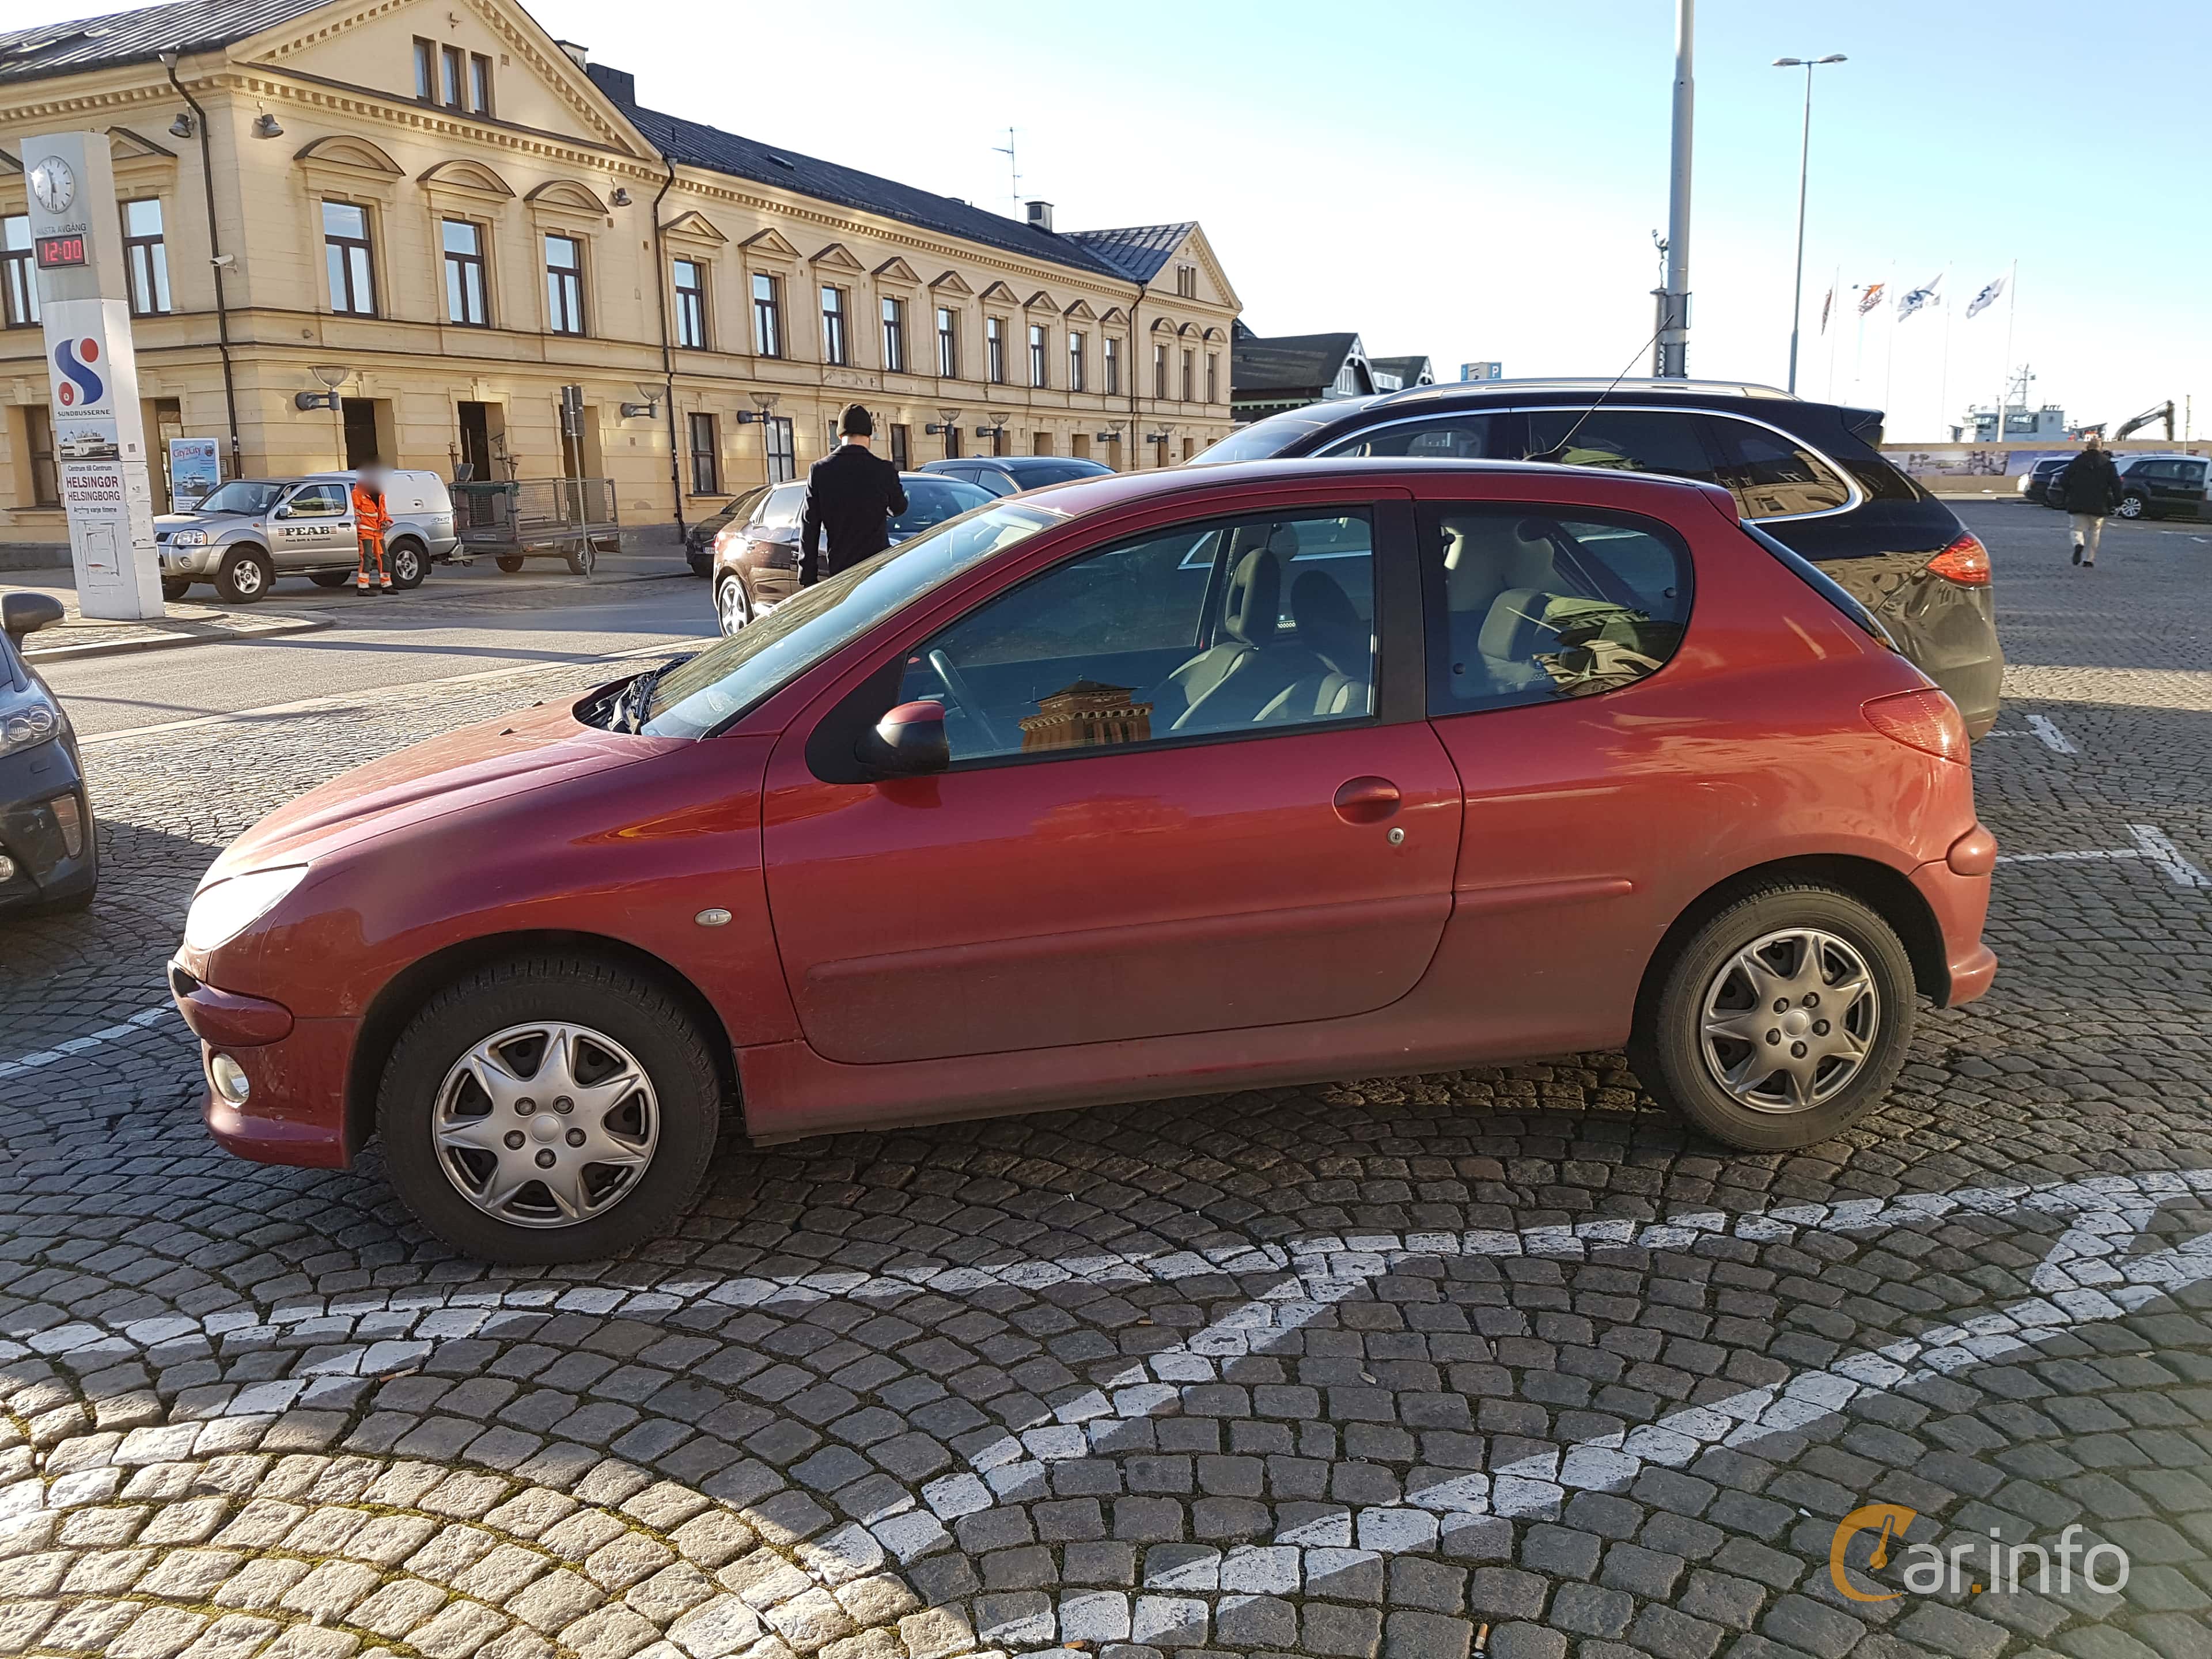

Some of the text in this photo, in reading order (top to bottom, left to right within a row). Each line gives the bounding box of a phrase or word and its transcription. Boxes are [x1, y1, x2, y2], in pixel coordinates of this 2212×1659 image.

[45, 240, 82, 262] 12:00
[1492, 365, 1499, 378] P
[57, 409, 111, 417] SUNDBUSSERNE
[66, 476, 119, 488] HELSINGØR
[68, 490, 120, 501] HELSINGBORG
[285, 526, 330, 536] PEAB
